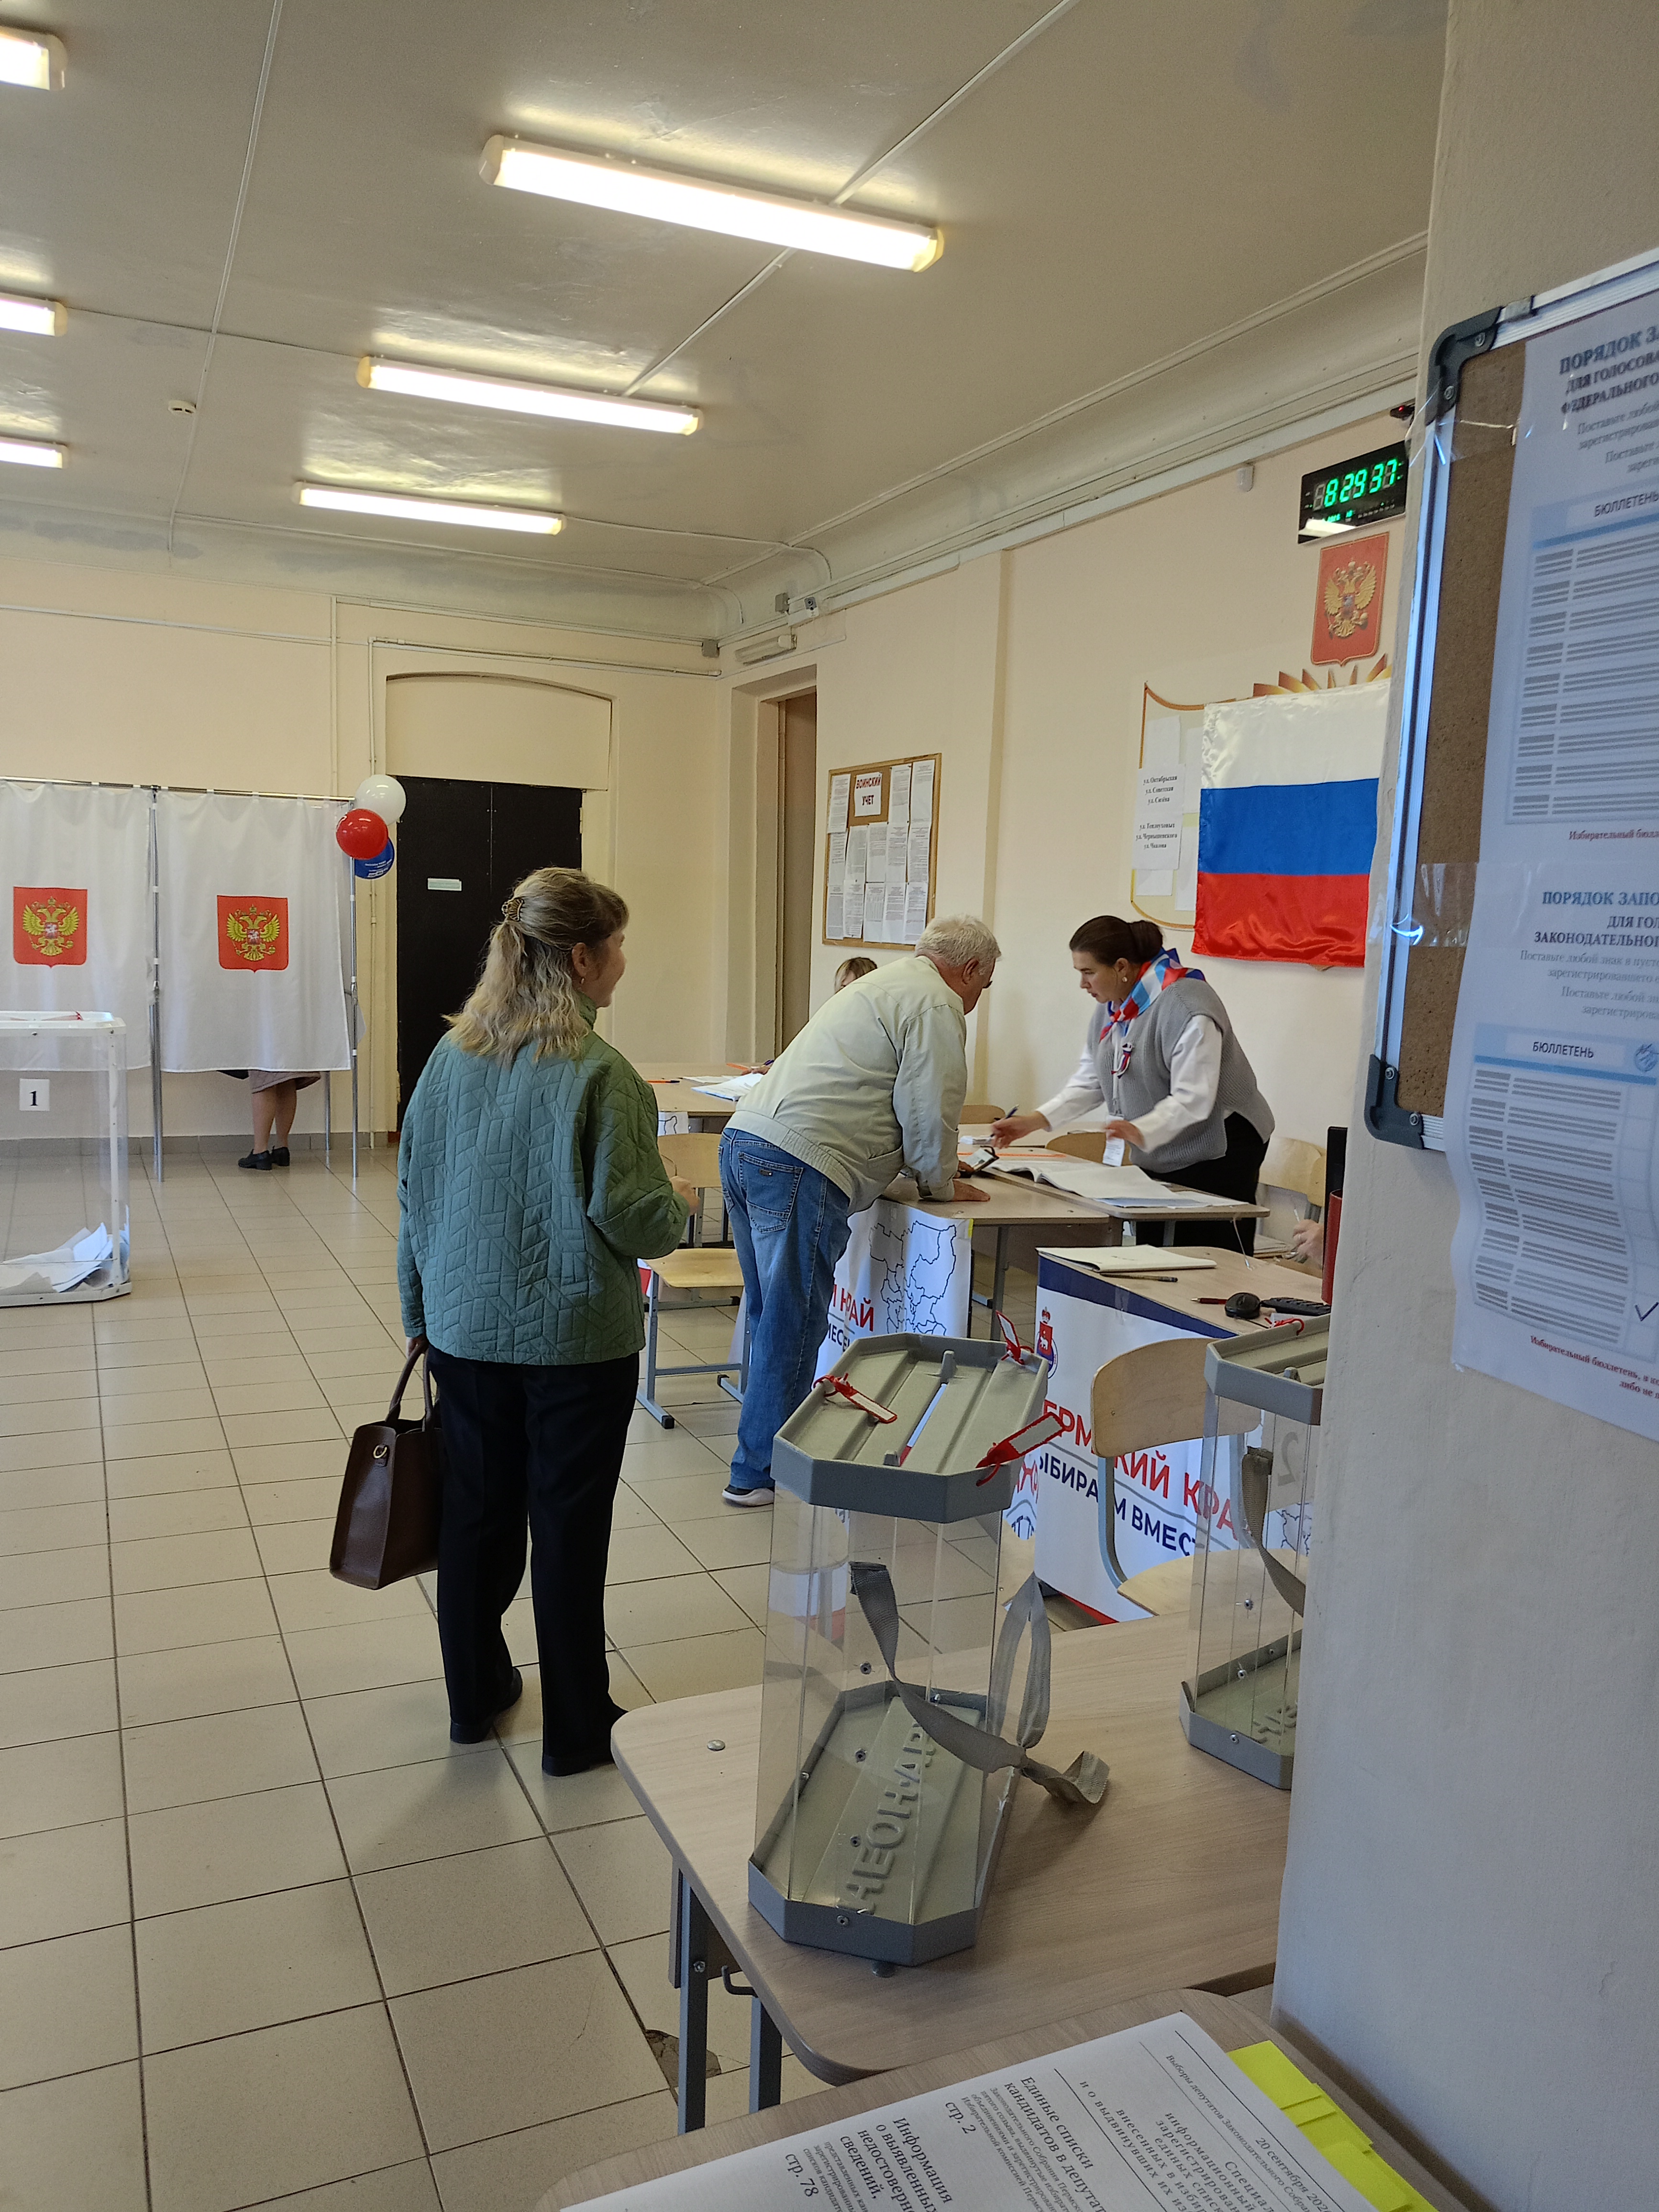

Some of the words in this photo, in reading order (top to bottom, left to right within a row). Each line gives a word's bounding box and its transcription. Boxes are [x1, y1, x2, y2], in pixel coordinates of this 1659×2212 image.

[1559, 331, 1642, 375] ПОРЯДОК
[1594, 491, 1659, 517] БЮЛЛЕТЕНЬ
[862, 795, 874, 806] УЧЕТ
[1150, 775, 1177, 784] Октябрьская
[1143, 833, 1177, 841] Чернышевского
[1569, 830, 1635, 841] Избирательный
[1542, 891, 1614, 907] ПОРЯДОК
[1607, 916, 1634, 929] ДЛЯ
[1520, 950, 1565, 962] Поставьте
[1560, 986, 1610, 999] Поставьте
[1533, 1041, 1594, 1058] БЮЛЛЕТЕНЬ
[29, 1090, 38, 1106] 1
[1530, 1335, 1590, 1364] Избирательный
[1183, 1472, 1238, 1541] КРА
[1132, 1504, 1206, 1557] ВМЕС
[845, 1722, 936, 1915] НЕОН-АР
[875, 2124, 887, 2132] о
[945, 2101, 964, 2124] стр.
[962, 2124, 976, 2134] 2
[990, 2087, 1034, 2146] Законодательного
[1032, 2146, 1061, 2182] Собрания
[1004, 2082, 1060, 2152] кандидатов
[1055, 2154, 1067, 2163] в
[1020, 2076, 1060, 2123] Единые
[1056, 2124, 1094, 2169] списки
[1116, 2109, 1167, 2169] внесенных
[1166, 2055, 1194, 2085] Выборы
[1190, 2084, 1225, 2120] депутатов
[1222, 2119, 1285, 2187] Законодательного
[893, 2117, 953, 2204] Информация
[961, 2096, 1000, 2147] Избирательной
[996, 2146, 1028, 2187] комиссией
[1014, 2137, 1049, 2182] выдвинутые
[1095, 2101, 1159, 2179] выдвинувших
[1157, 2180, 1173, 2196] их
[1172, 2198, 1188, 2212] из
[1154, 2137, 1193, 2179] единых
[785, 2153, 804, 2178] стр.
[800, 2178, 819, 2198] 78
[824, 2141, 861, 2198] представленных
[840, 2135, 885, 2200] сведений,
[1255, 2137, 1270, 2150] 20
[1267, 2150, 1309, 2194] сентября
[1306, 2193, 1330, 2212] 202
